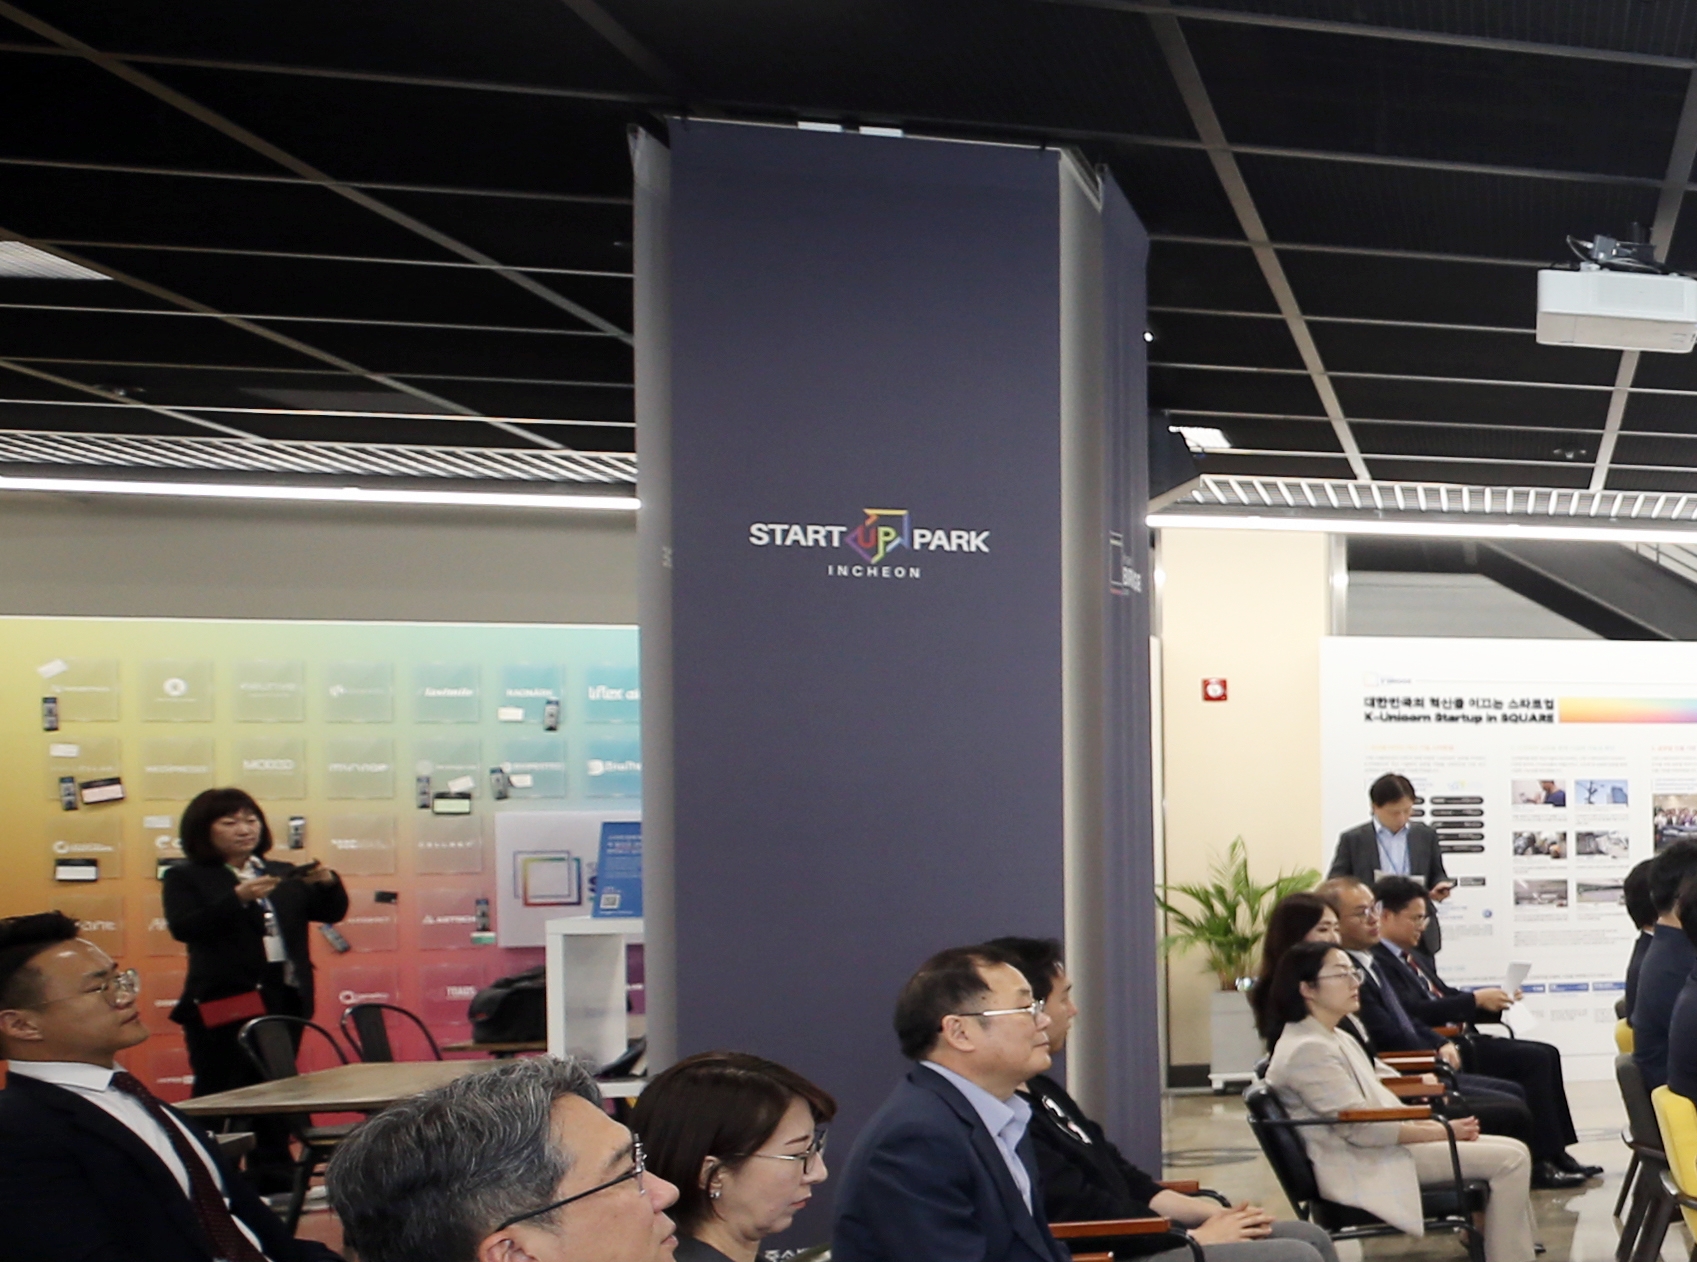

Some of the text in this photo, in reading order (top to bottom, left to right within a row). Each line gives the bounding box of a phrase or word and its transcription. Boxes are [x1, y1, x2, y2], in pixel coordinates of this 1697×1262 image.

[749, 522, 847, 547] START
[912, 528, 990, 553] PARK
[827, 564, 921, 579] INCHEON
[1508, 698, 1554, 710] 스타트업
[1435, 713, 1482, 724] Startup
[1486, 713, 1497, 722] in
[1501, 714, 1554, 723] SQUARE
